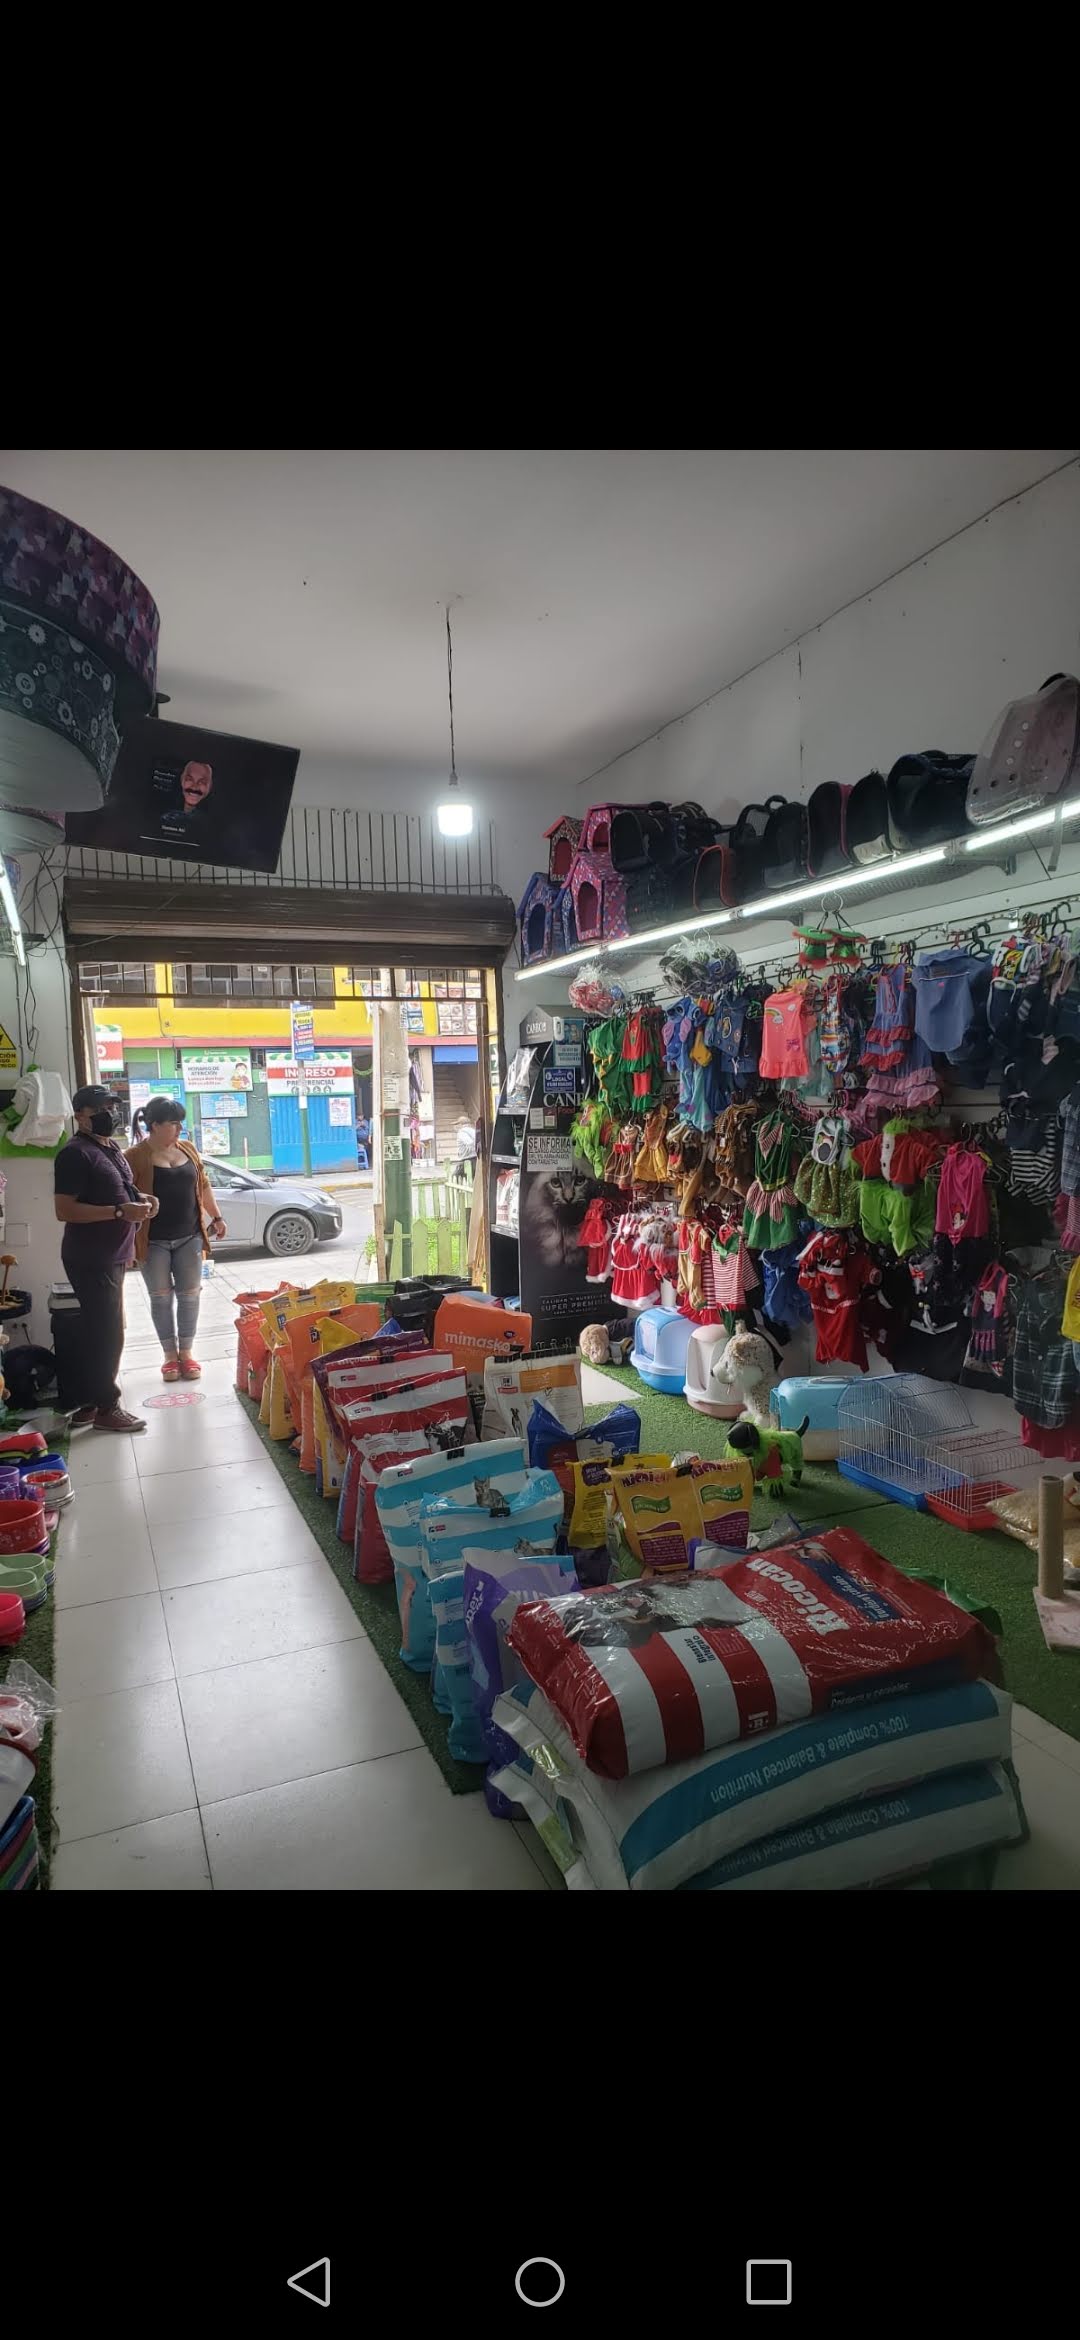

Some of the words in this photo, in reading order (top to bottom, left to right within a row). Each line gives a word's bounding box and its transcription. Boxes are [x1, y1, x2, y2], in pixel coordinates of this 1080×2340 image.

[284, 1067, 336, 1078] INRESO
[528, 1137, 538, 1149] SE
[539, 1137, 572, 1149] INFORMA
[444, 1331, 518, 1353] mimasko
[746, 1557, 851, 1636] Ricocan
[827, 1722, 879, 1750] Complete
[880, 1712, 910, 1735] 100%
[764, 1746, 816, 1778] Balanced
[817, 1743, 827, 1759] &
[710, 1772, 764, 1804] Nutrition
[827, 1808, 879, 1835] Complete
